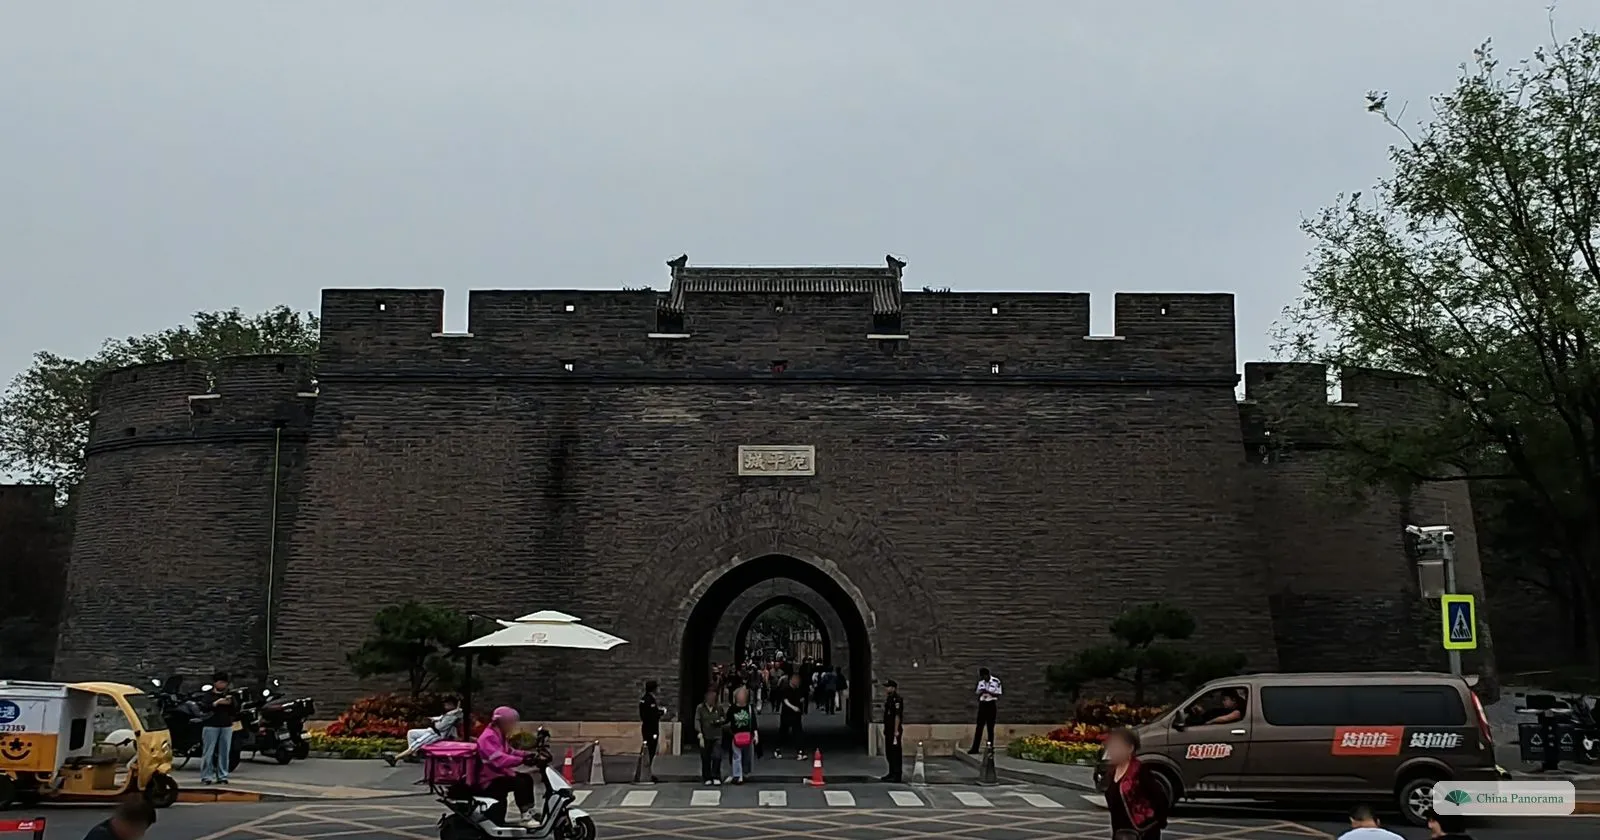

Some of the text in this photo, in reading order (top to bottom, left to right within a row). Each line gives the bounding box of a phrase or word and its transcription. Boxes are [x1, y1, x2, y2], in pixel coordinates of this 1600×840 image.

[1340, 732, 1394, 748] 货拉拉
[1409, 732, 1463, 749] 货拉拉
